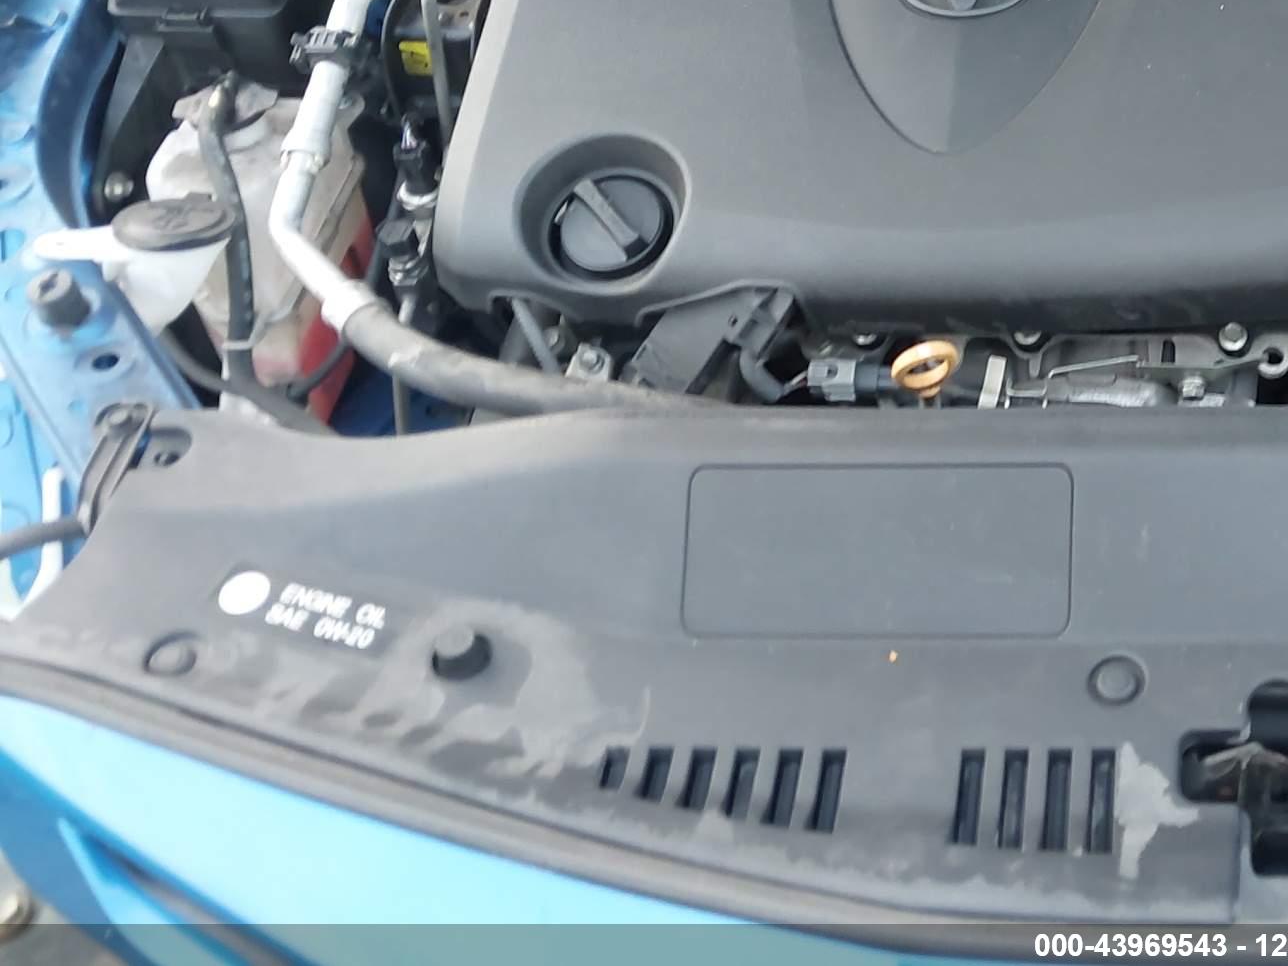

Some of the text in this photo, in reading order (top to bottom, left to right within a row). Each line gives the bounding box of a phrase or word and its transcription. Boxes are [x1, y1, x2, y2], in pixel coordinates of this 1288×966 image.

[265, 604, 309, 631] SAE
[280, 582, 386, 629] ENGINE OIL
